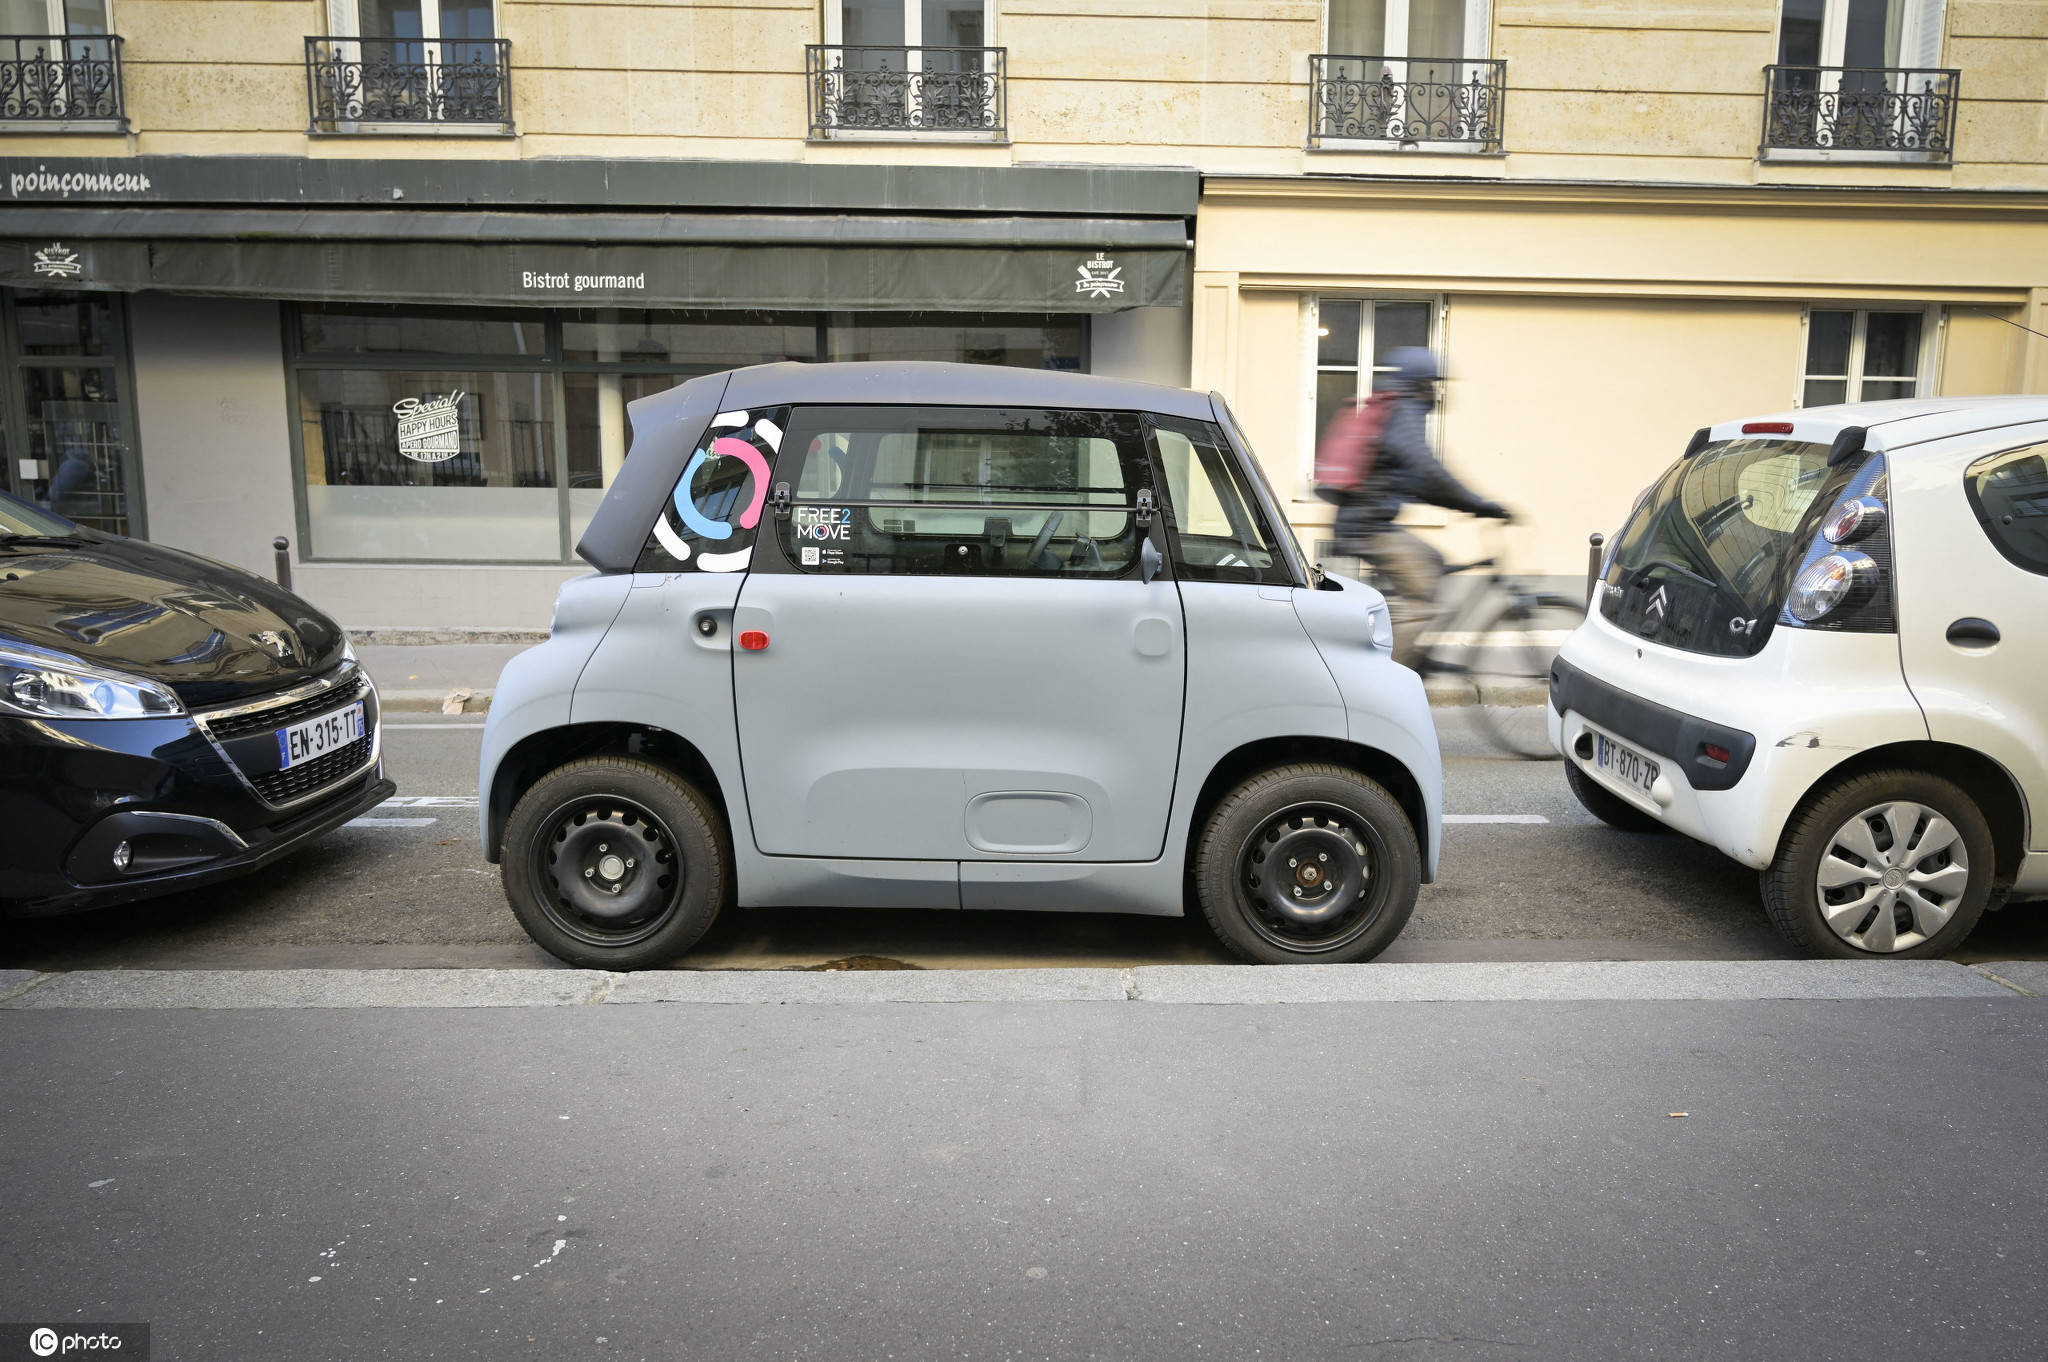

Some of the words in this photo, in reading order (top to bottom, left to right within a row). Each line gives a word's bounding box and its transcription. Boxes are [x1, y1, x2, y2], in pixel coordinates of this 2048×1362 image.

[11, 164, 151, 198] poinçonneur
[1087, 260, 1114, 269] BISTROT
[1096, 252, 1105, 261] LE
[523, 271, 570, 289] Bistrot
[574, 272, 645, 292] gourmand
[400, 421, 428, 437] HAPPY
[429, 413, 457, 431] HOURS
[797, 507, 852, 524] FREE2
[797, 524, 852, 540] MOVE
[1729, 616, 1758, 636] C1
